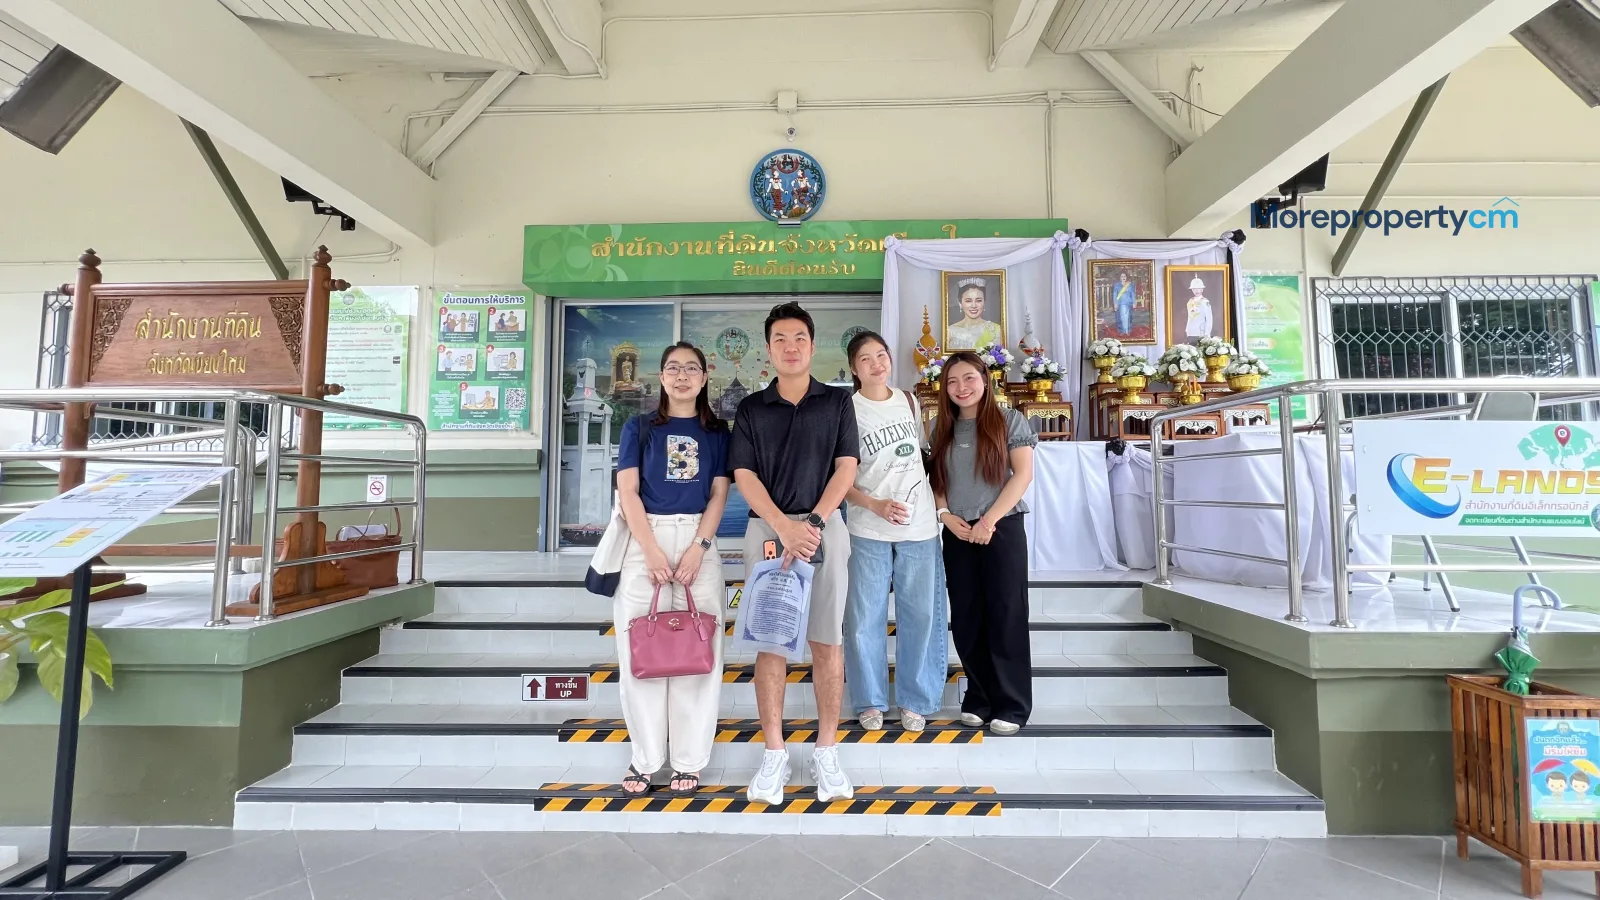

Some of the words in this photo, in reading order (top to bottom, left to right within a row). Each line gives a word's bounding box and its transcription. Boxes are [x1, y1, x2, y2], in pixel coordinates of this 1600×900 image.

[732, 260, 856, 276] ยินดีต้อนรับ
[443, 293, 525, 305] ขั้นตอนการให้บริการ
[135, 303, 262, 340] สำนักงานที่ดิน
[666, 435, 700, 480] B
[1465, 499, 1589, 511] สำนักงานที่ดินอิเล็กทรอนิกส์
[555, 677, 578, 689] ทางขึ้น
[560, 690, 572, 698] UP
